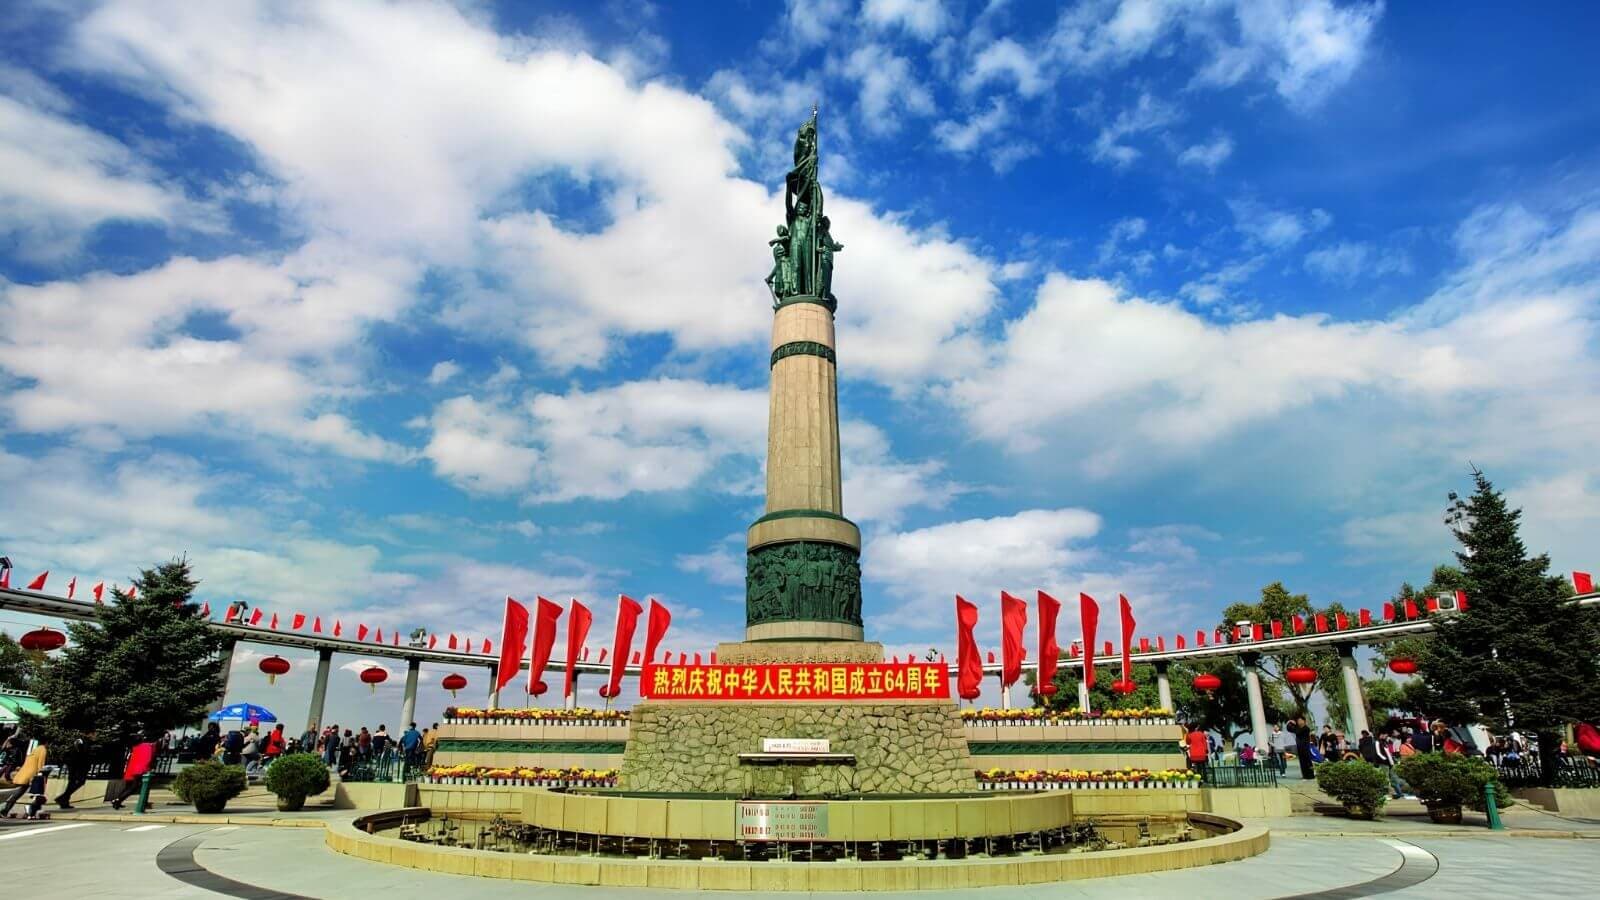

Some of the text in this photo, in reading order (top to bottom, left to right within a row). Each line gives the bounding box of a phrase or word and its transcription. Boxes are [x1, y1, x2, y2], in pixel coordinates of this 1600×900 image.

[654, 667, 941, 696] 热烈庆祝中华人民共和国成立64周年
